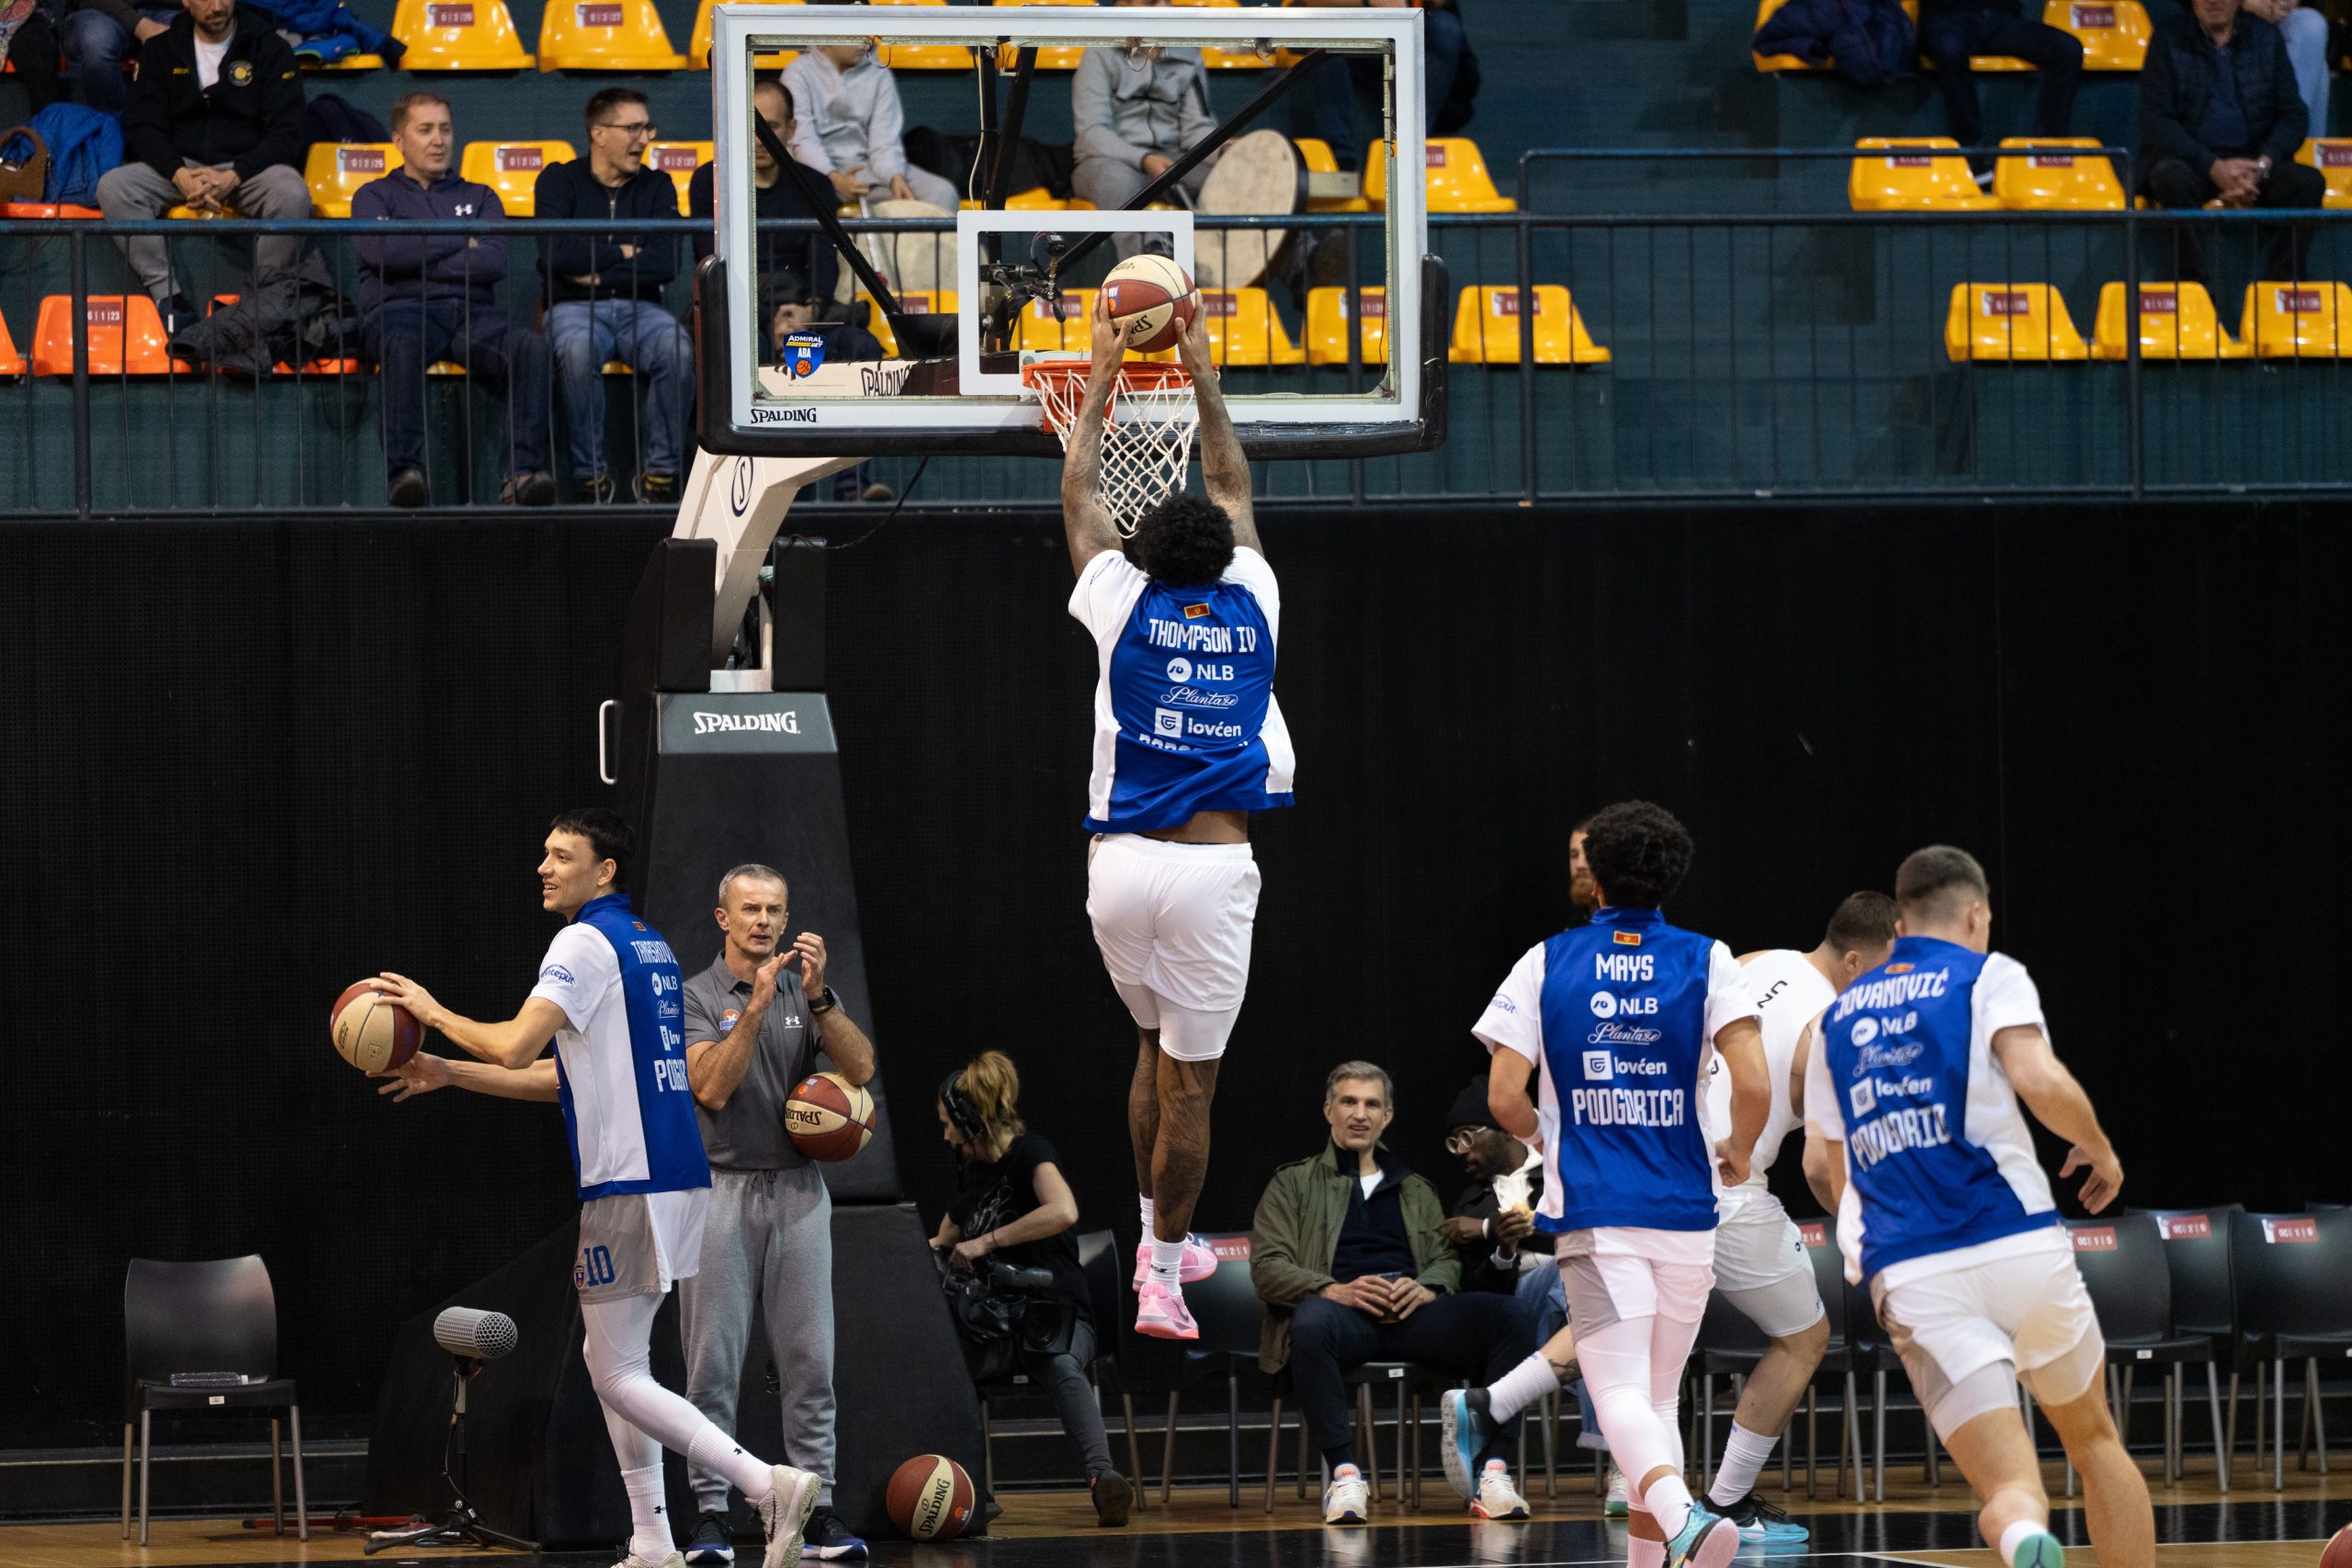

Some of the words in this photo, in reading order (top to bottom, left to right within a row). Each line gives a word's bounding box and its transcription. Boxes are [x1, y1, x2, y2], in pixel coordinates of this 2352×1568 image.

[787, 334, 824, 344] ADMIRAL
[797, 347, 811, 358] ABA
[861, 364, 913, 396] SPALDIN
[751, 407, 817, 424] SPALDING
[1148, 618, 1232, 652] THOMPSON
[1236, 626, 1257, 653] IV
[1196, 663, 1235, 681] NLB
[1160, 685, 1239, 708] Plantaže
[693, 710, 798, 735] SPALDING
[1188, 717, 1242, 737] lovćen
[1596, 953, 1654, 982] MAYS
[662, 976, 678, 990] NLB
[1833, 967, 1950, 1022] JOVANOVIĆ
[1619, 997, 1658, 1015] NLB
[1588, 1021, 1662, 1045] Plantaže
[1881, 1010, 1919, 1037] NLB
[1614, 1057, 1668, 1076] lovćen
[1571, 1088, 1684, 1127] PODGORICA
[583, 1246, 616, 1287] 10
[919, 1478, 951, 1534] SPALDING
